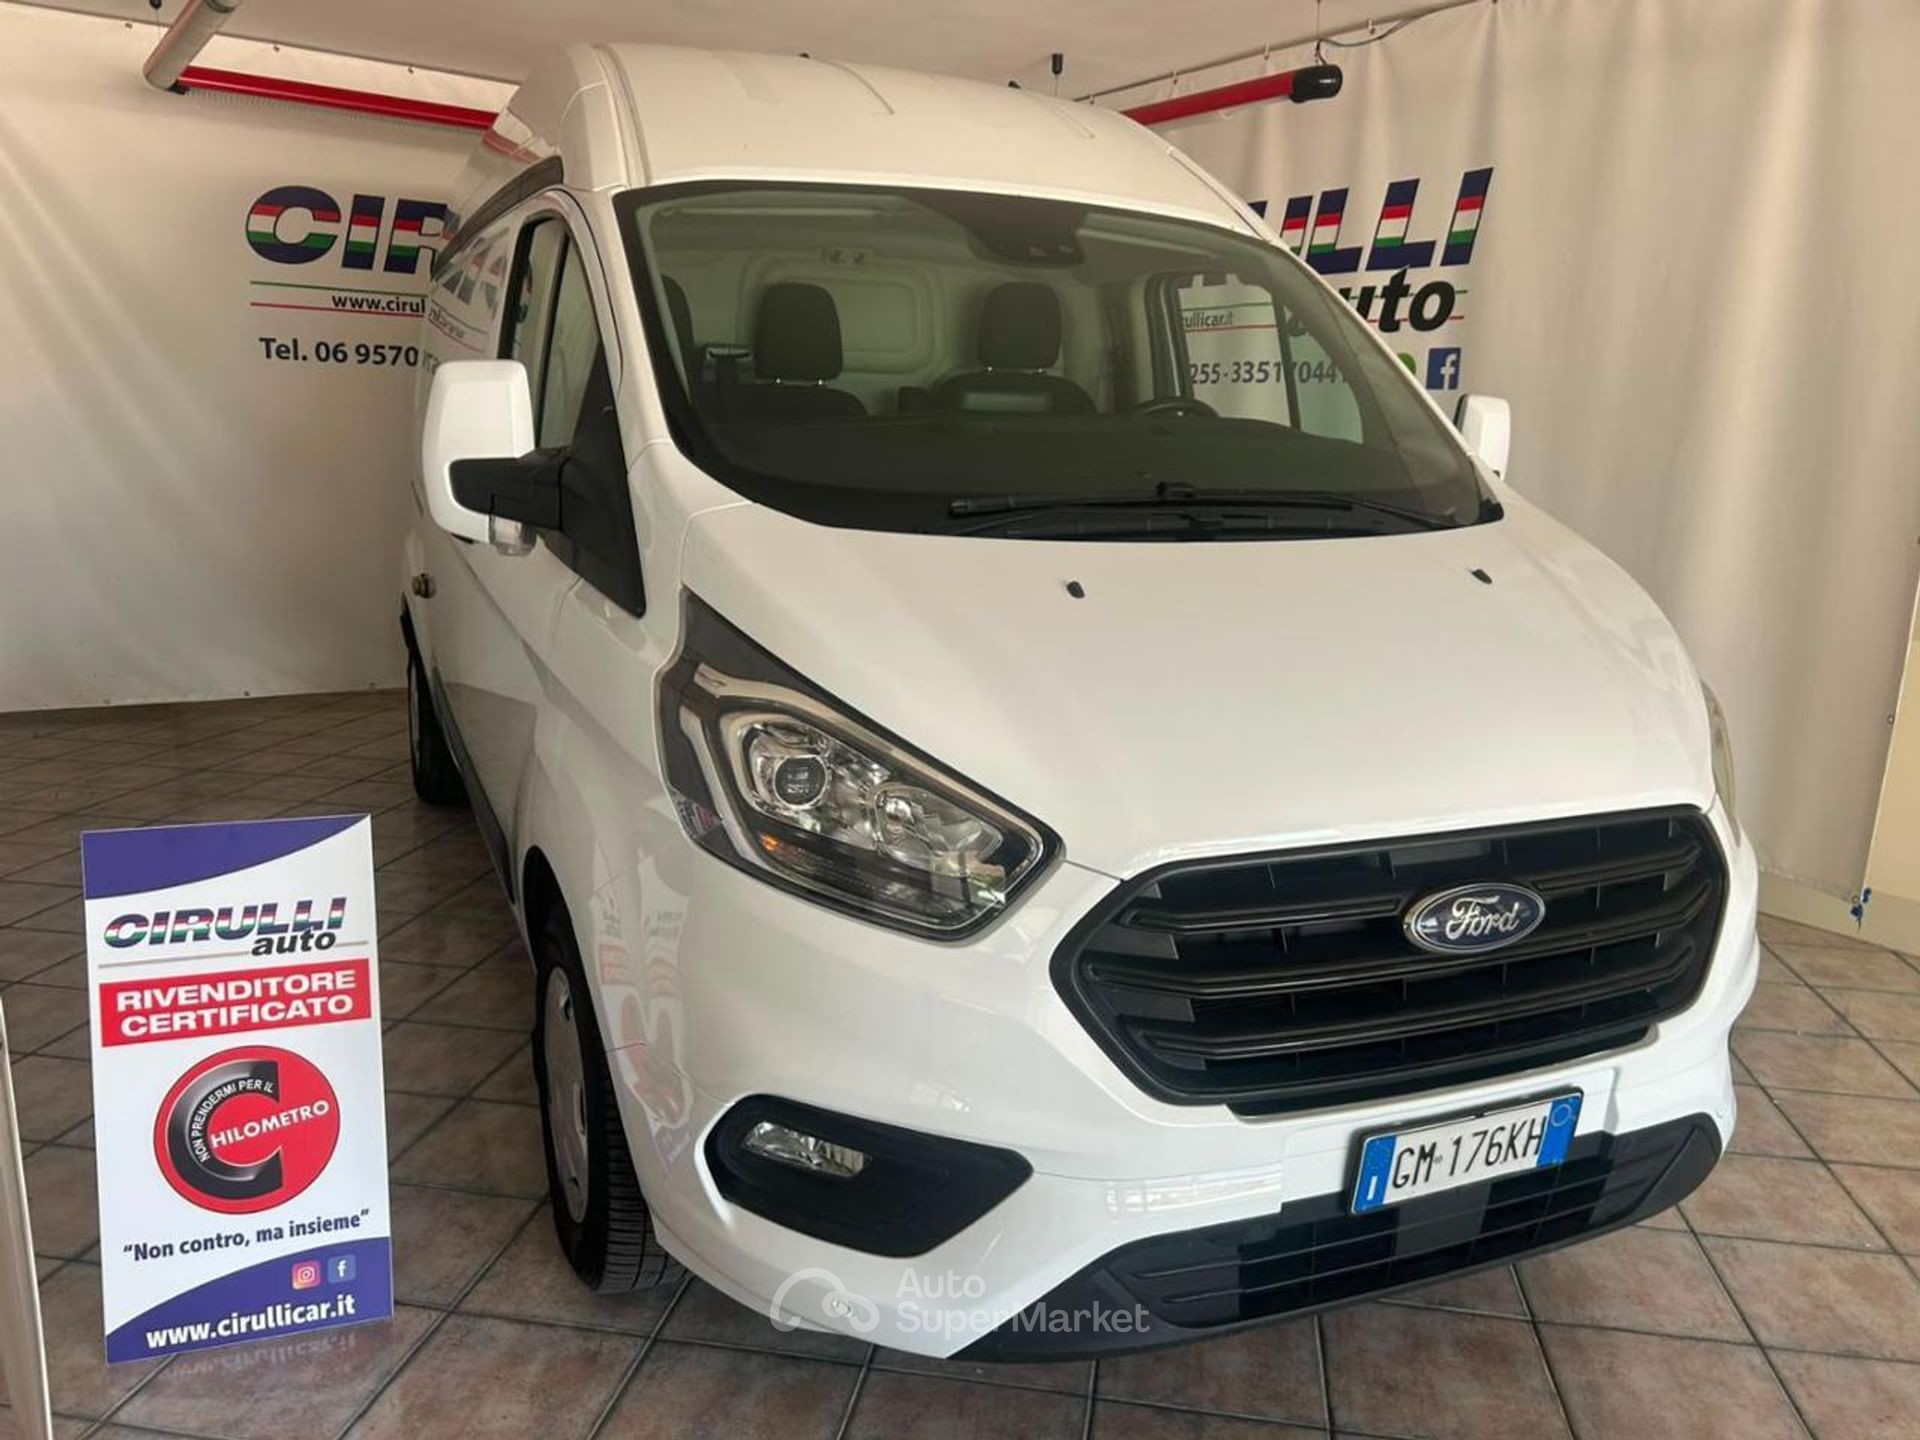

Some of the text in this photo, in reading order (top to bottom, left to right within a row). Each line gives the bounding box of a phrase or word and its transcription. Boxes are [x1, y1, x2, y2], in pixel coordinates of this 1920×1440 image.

[259, 337, 308, 362] Tel.
[315, 341, 348, 363] 06
[355, 343, 419, 367] 9570
[103, 897, 348, 949] CIRULLI
[1445, 894, 1520, 940] Ford
[250, 926, 337, 957] auto
[116, 969, 356, 1013] RIVENDITORE
[120, 994, 353, 1038] CERTIFICATO
[191, 1078, 275, 1163] NON PRENDERMI PER IL
[179, 1230, 251, 1256] contro,
[255, 1224, 285, 1243] ma
[145, 1293, 357, 1350] www.cirullicar.it
